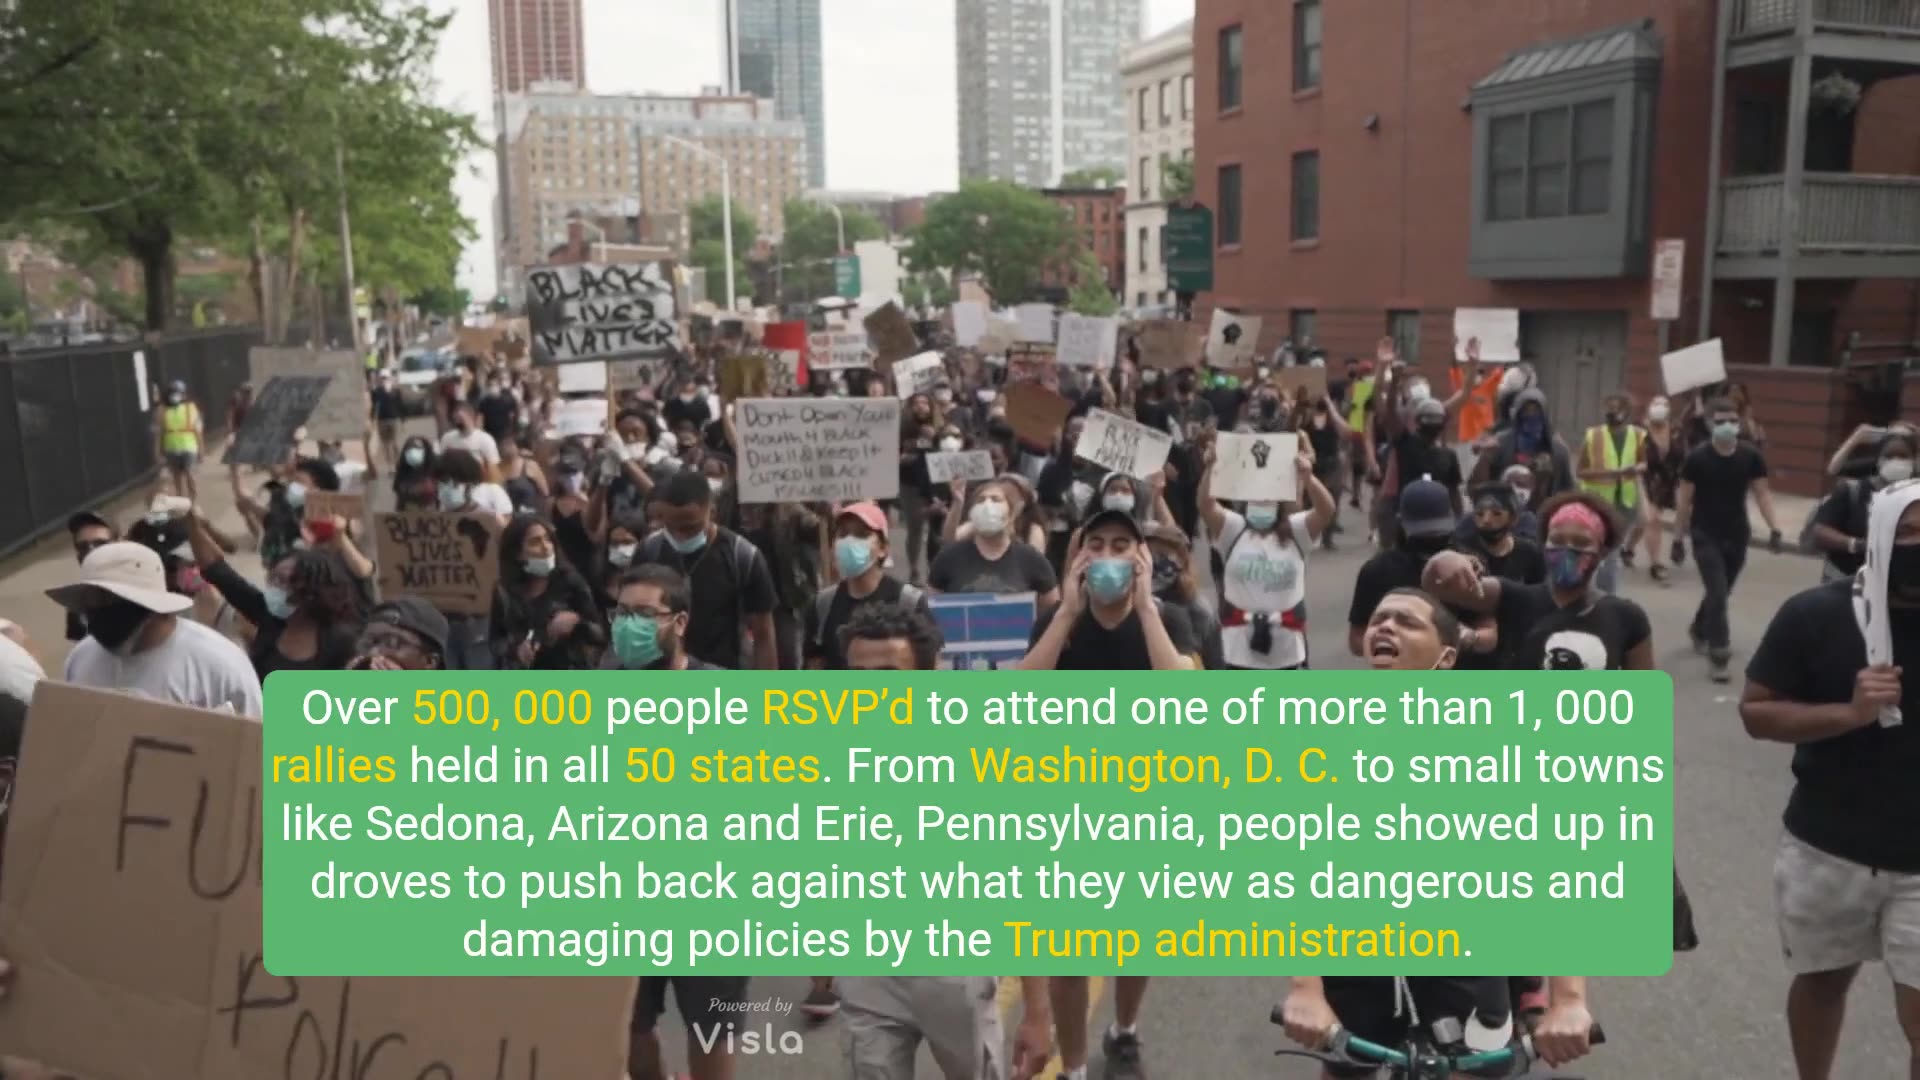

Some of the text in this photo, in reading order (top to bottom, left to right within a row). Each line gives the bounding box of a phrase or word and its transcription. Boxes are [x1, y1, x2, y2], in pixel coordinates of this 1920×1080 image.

[529, 263, 657, 304] BLACK
[541, 320, 676, 357] MATTER
[384, 516, 454, 544] BLACK
[407, 539, 464, 563] LIVES
[395, 562, 481, 589] MATTER
[115, 734, 263, 901] FU
